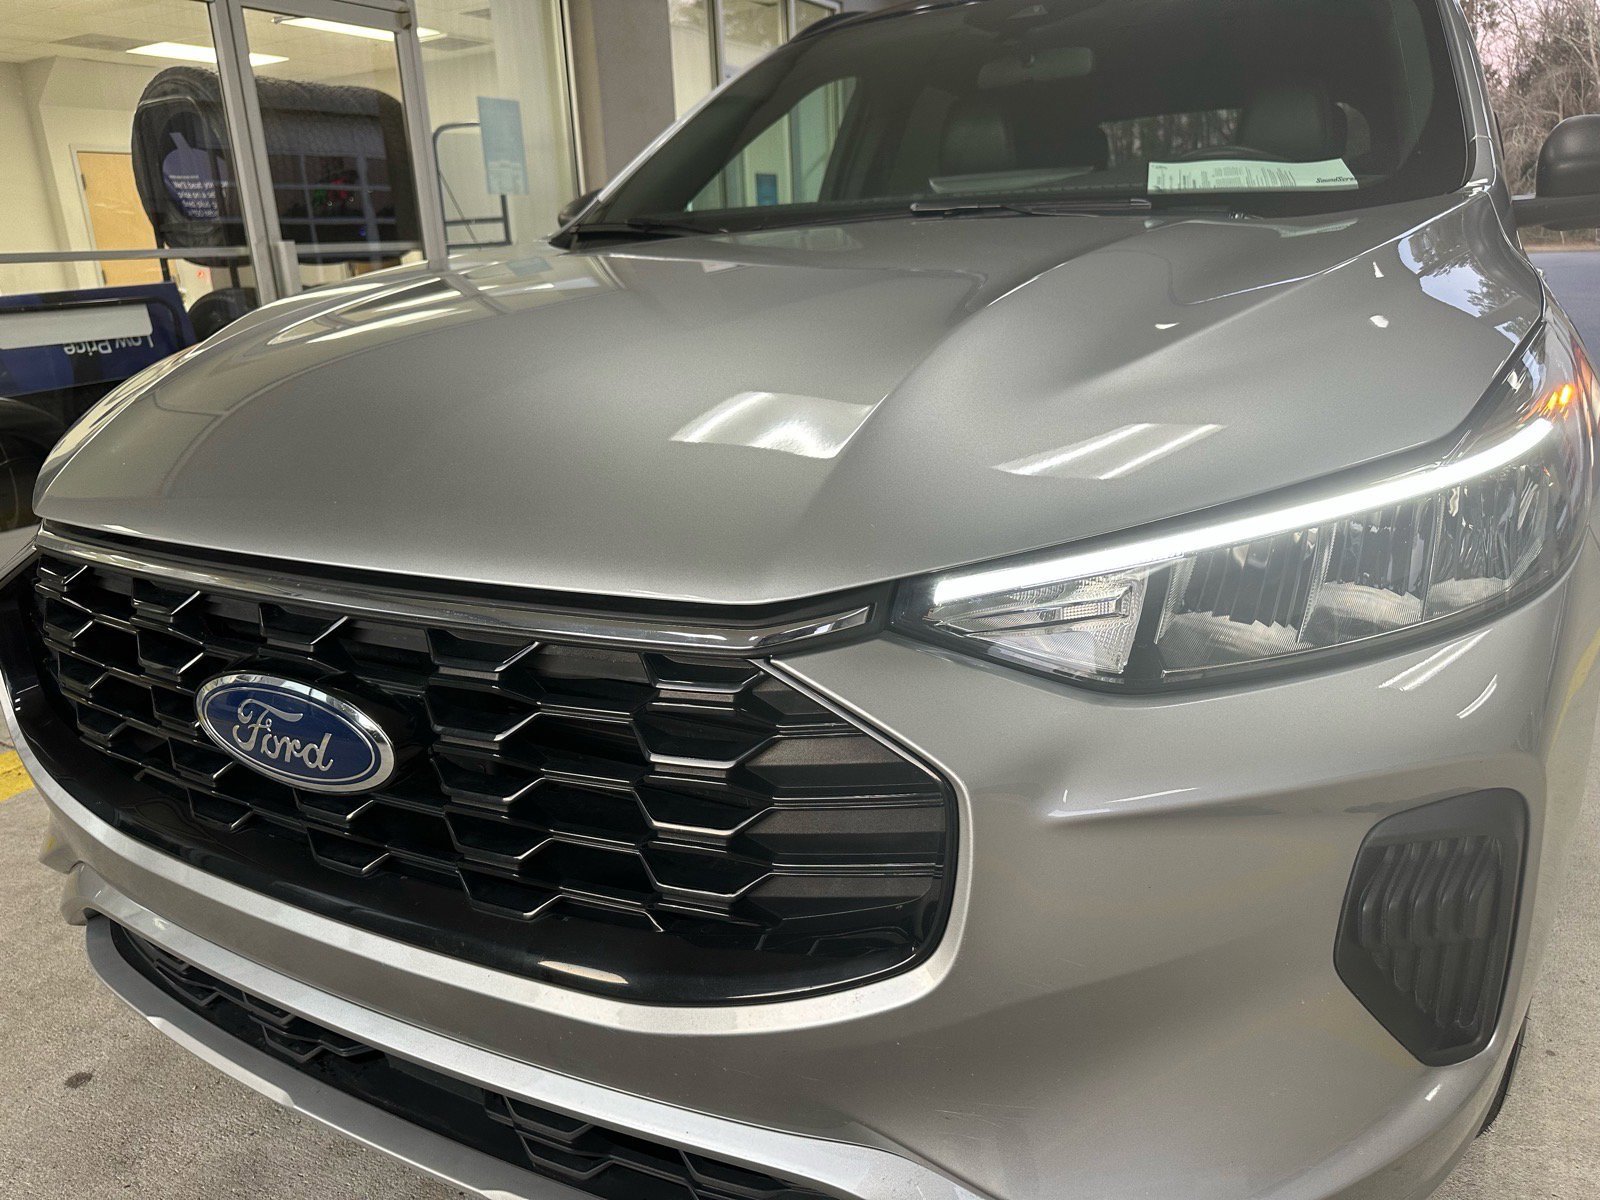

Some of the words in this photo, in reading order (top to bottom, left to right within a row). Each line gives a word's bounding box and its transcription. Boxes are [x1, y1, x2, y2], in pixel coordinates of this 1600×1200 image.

[63, 339, 113, 356] Price
[115, 335, 154, 349] Low
[232, 698, 334, 772] Ford
